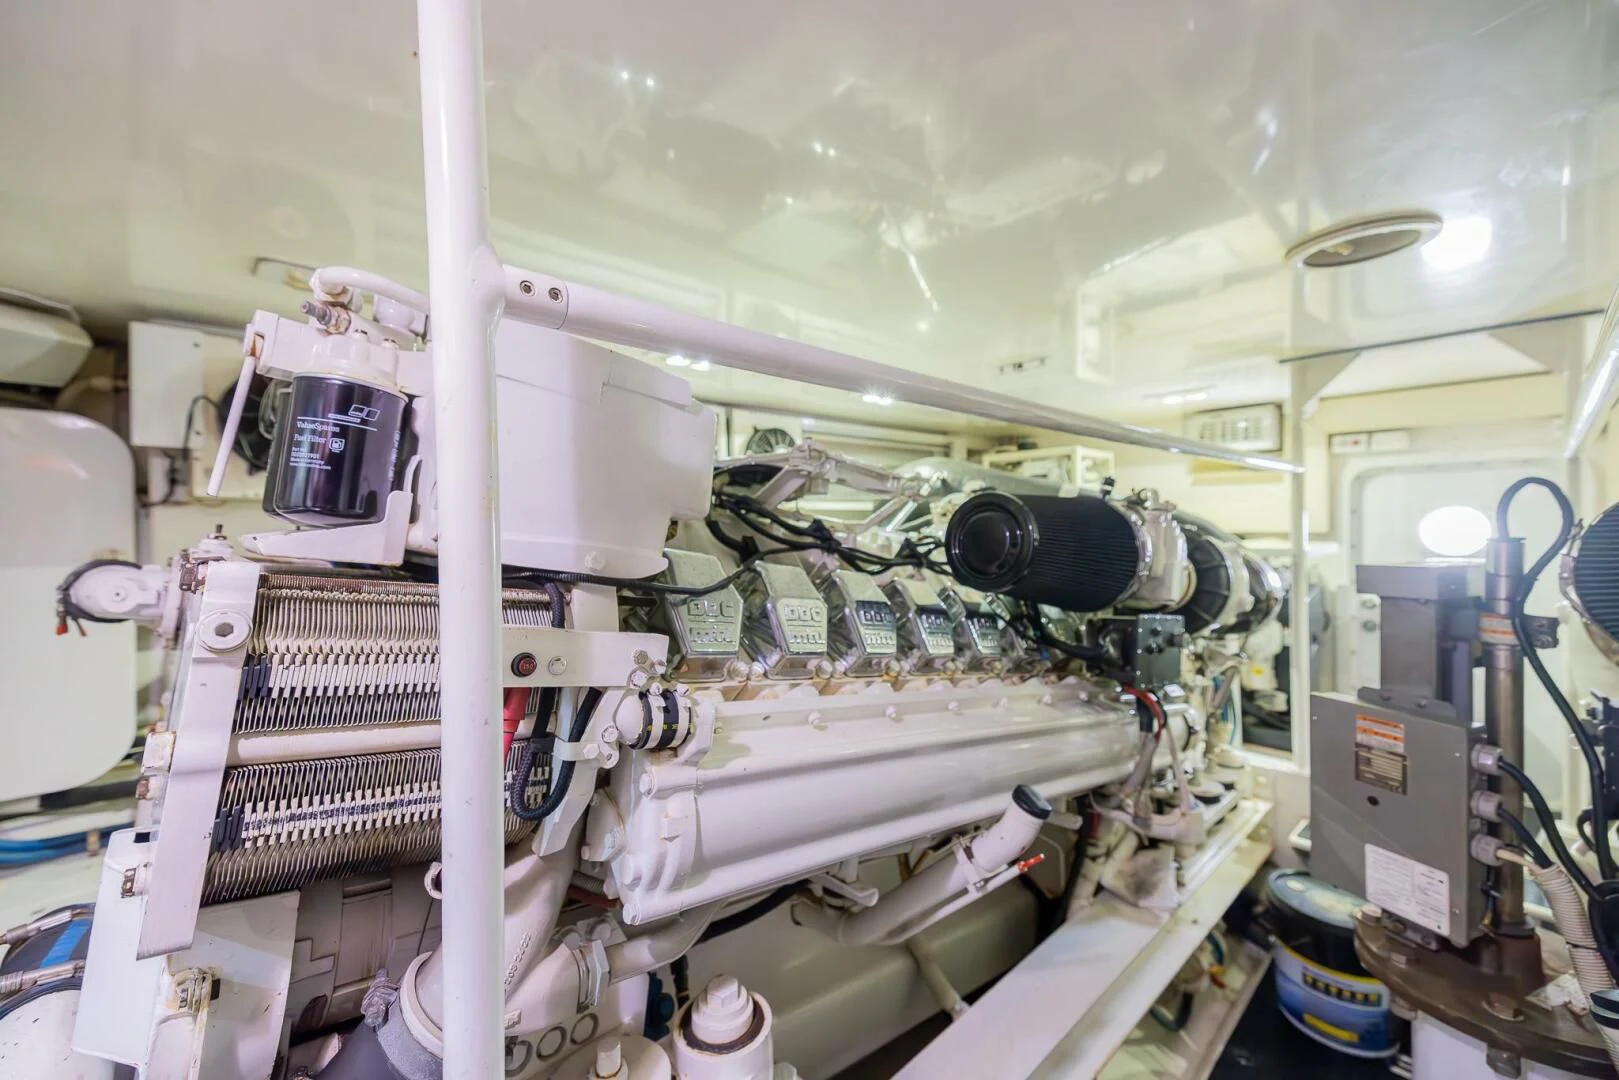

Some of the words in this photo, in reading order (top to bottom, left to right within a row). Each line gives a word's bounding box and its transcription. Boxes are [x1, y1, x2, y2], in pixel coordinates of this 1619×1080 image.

[297, 421, 340, 433] ValueSpares
[294, 433, 309, 441] Fuel
[308, 435, 327, 443] Filter
